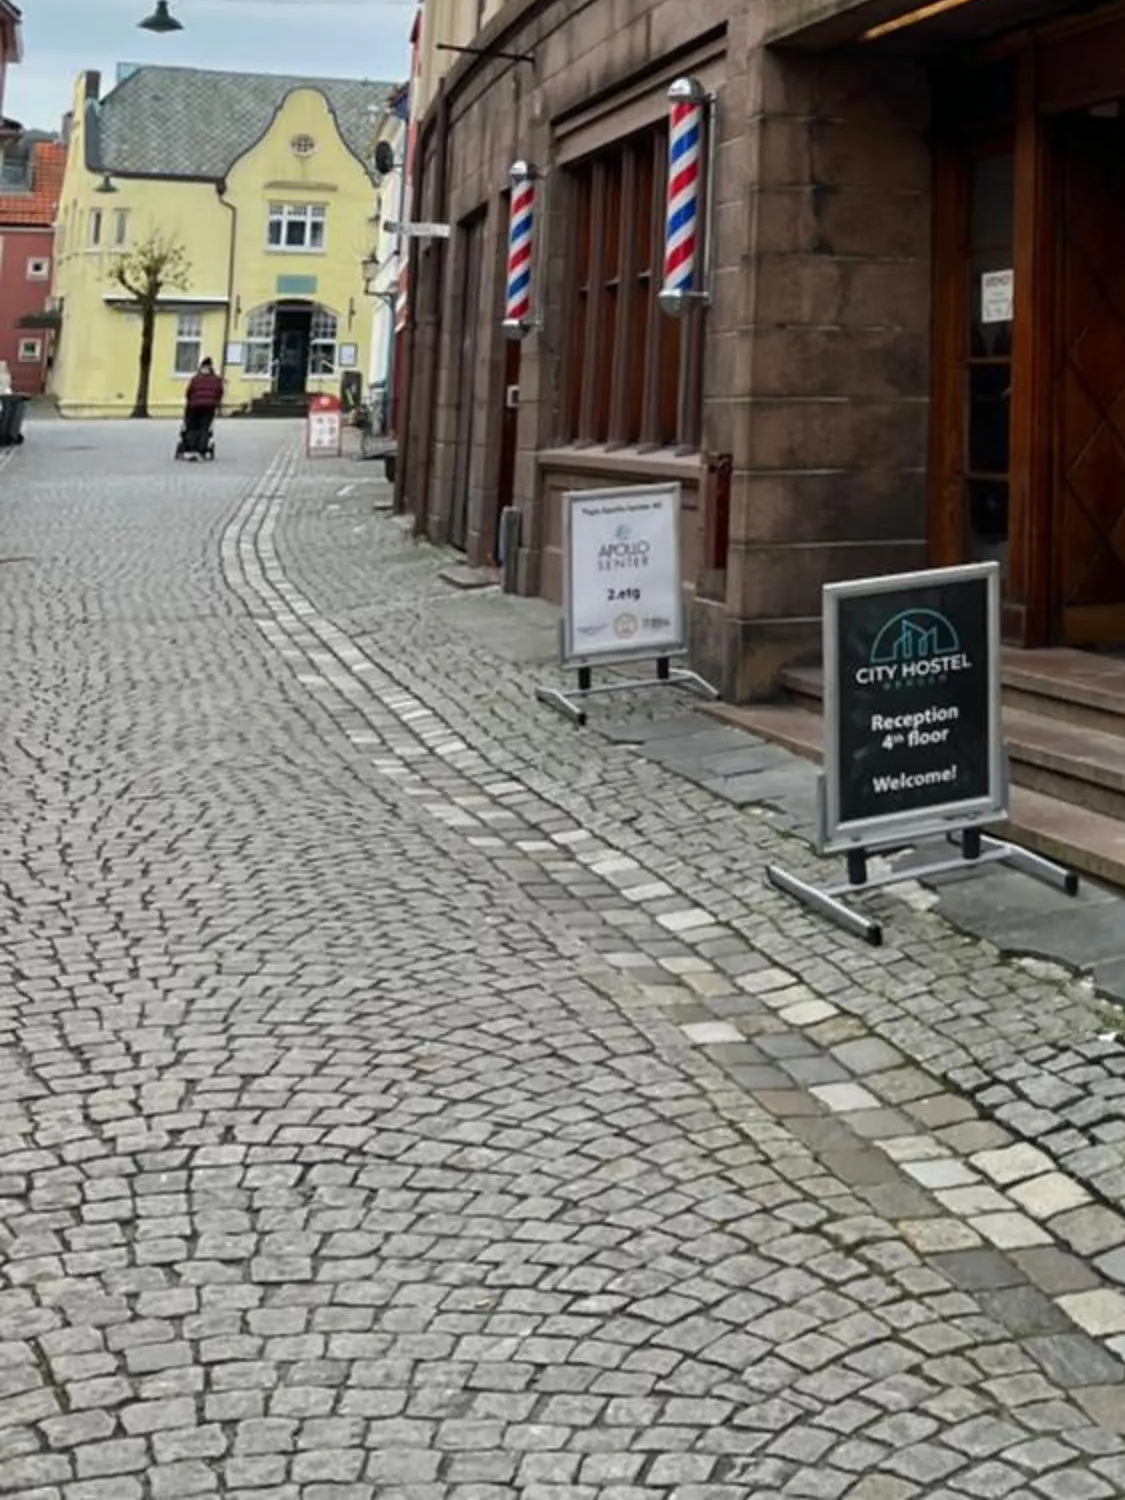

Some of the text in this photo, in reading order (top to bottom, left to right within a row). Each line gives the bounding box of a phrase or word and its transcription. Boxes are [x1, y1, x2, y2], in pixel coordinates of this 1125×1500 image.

[598, 539, 651, 558] APOLLO
[855, 663, 898, 685] CITY
[902, 652, 973, 677] HOSTEL
[871, 705, 959, 732] Reception
[881, 727, 949, 751] 4th floor
[872, 764, 957, 794] Welcome!
